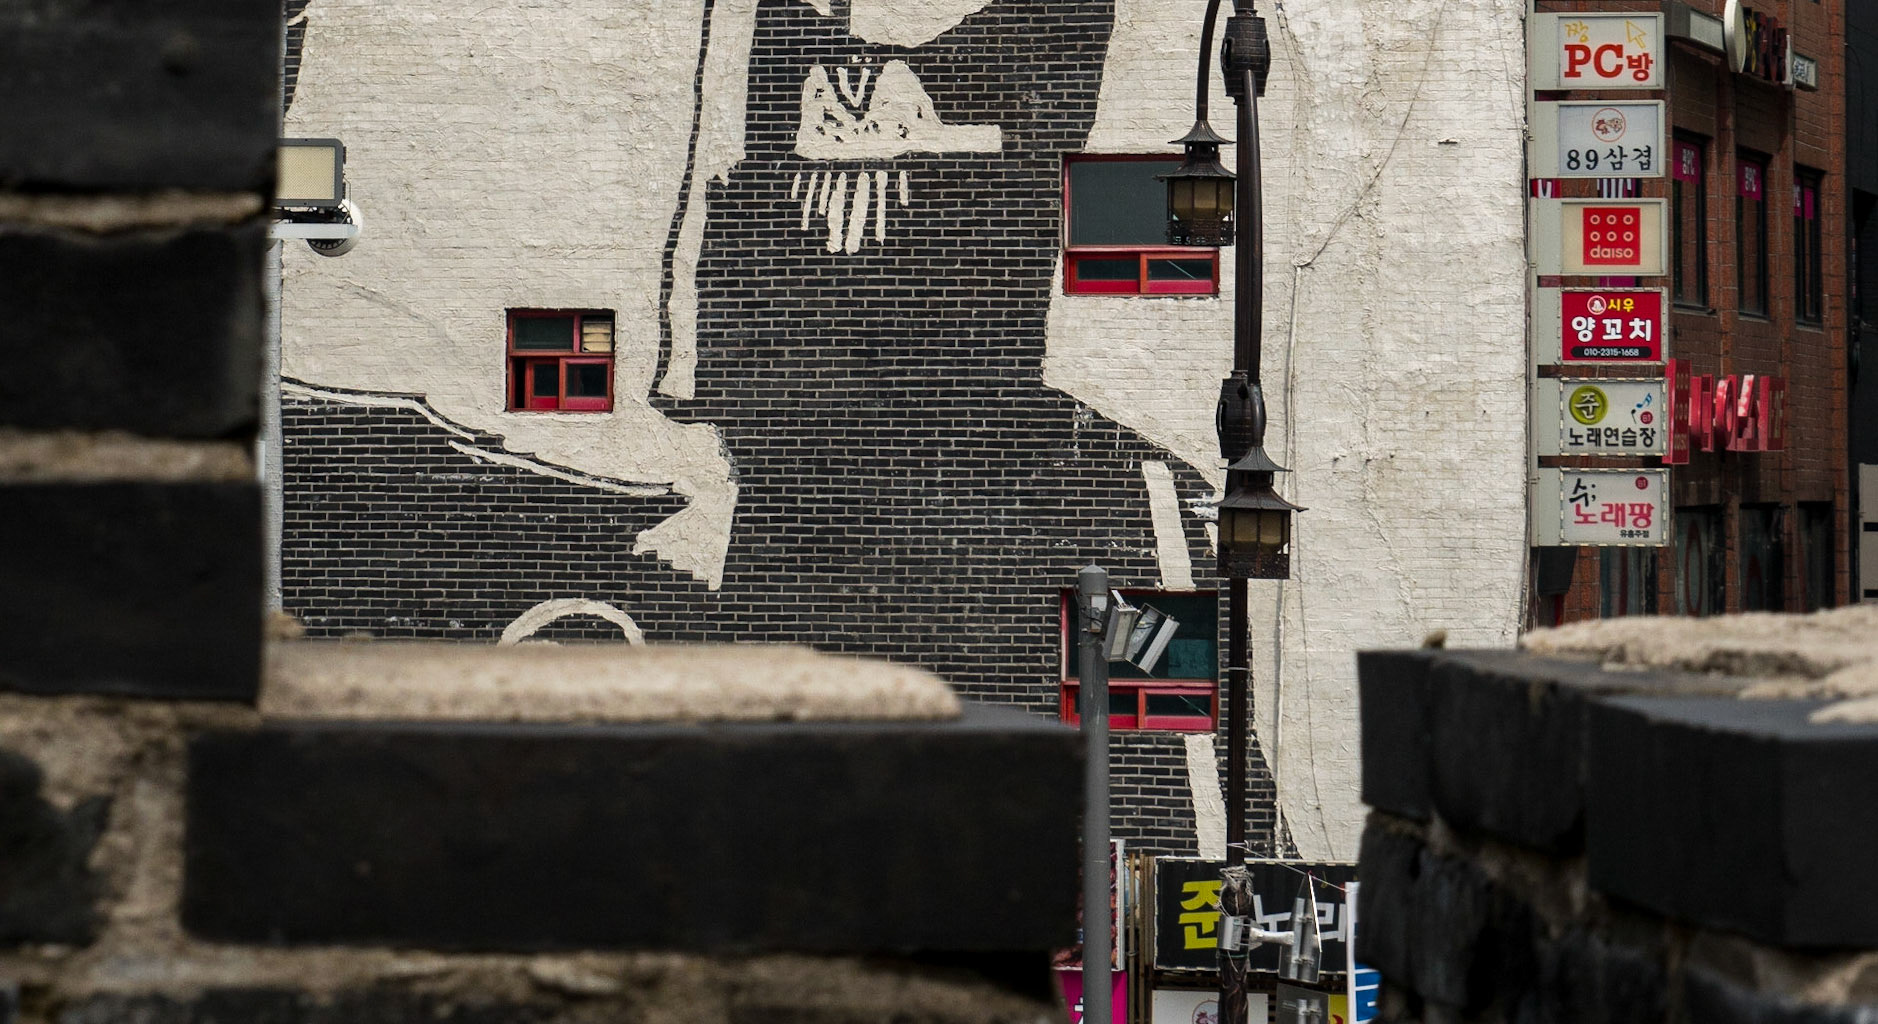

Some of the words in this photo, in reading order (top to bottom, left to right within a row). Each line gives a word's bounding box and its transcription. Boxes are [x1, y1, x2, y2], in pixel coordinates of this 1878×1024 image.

[1564, 44, 1653, 81] PC방
[1567, 145, 1651, 170] 89삼겹
[1590, 245, 1634, 258] daiso
[1608, 298, 1634, 312] 시우
[1571, 316, 1652, 342] 양꼬치
[1583, 348, 1639, 356] 010-2315-1658
[1575, 392, 1600, 419] 준
[1569, 427, 1656, 447] 노래연습장
[1574, 503, 1655, 528] 노래팡
